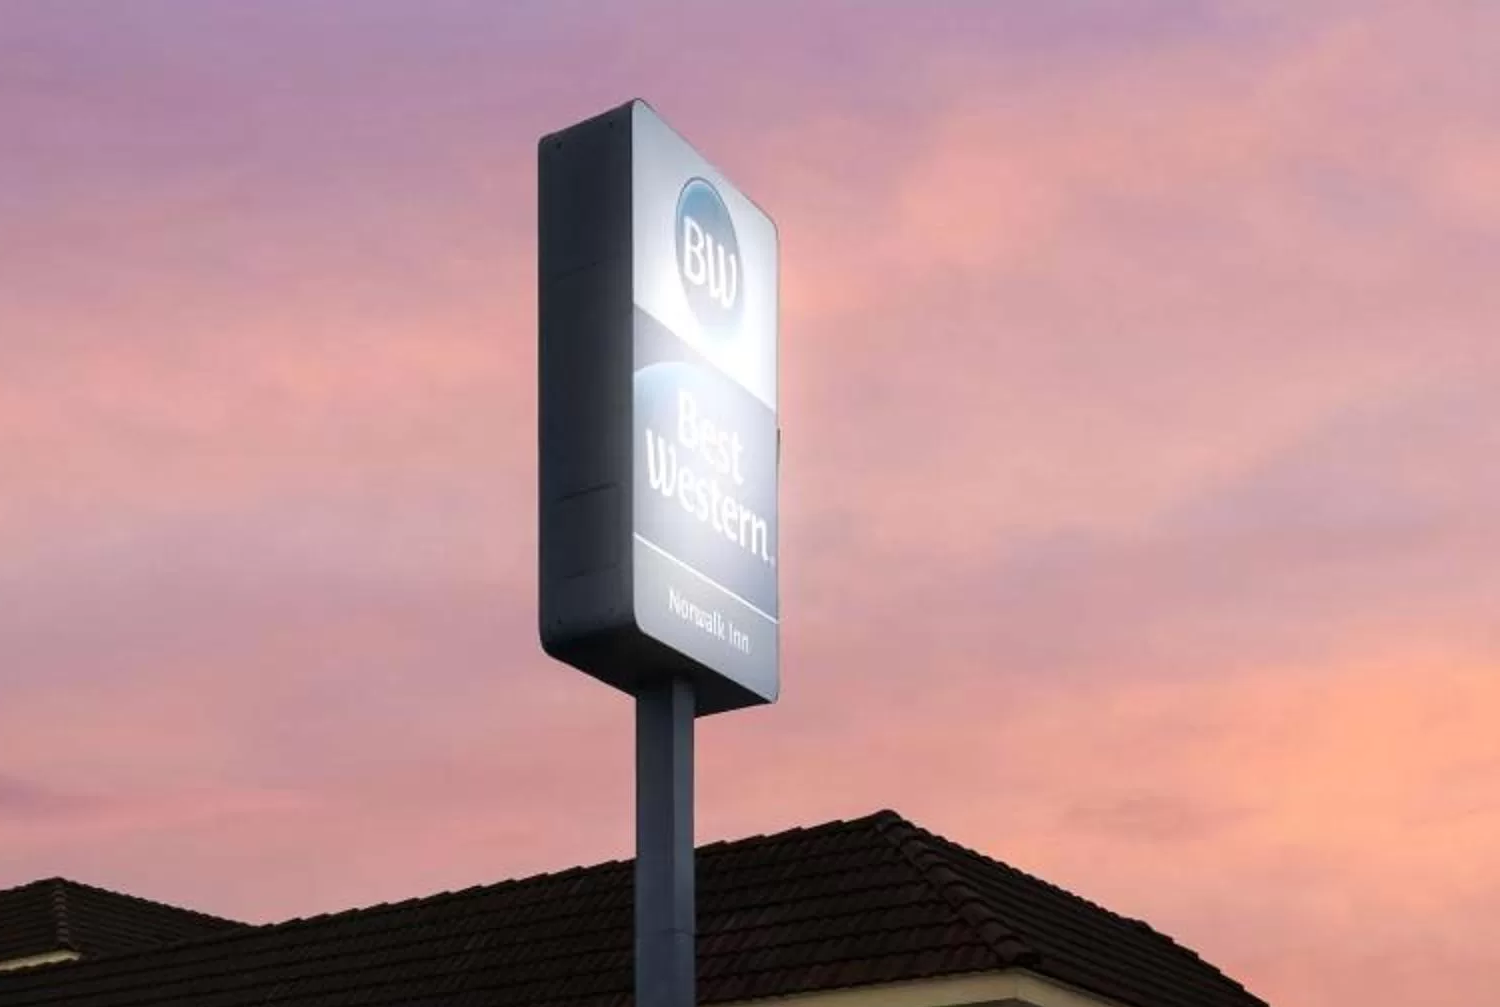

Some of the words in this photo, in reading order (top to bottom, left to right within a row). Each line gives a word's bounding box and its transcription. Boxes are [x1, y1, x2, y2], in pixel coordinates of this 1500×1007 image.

[683, 214, 738, 311] BW
[678, 386, 745, 488] Best
[645, 427, 770, 565] Western
[668, 587, 725, 641] Norwalk
[728, 621, 750, 654] Inn
